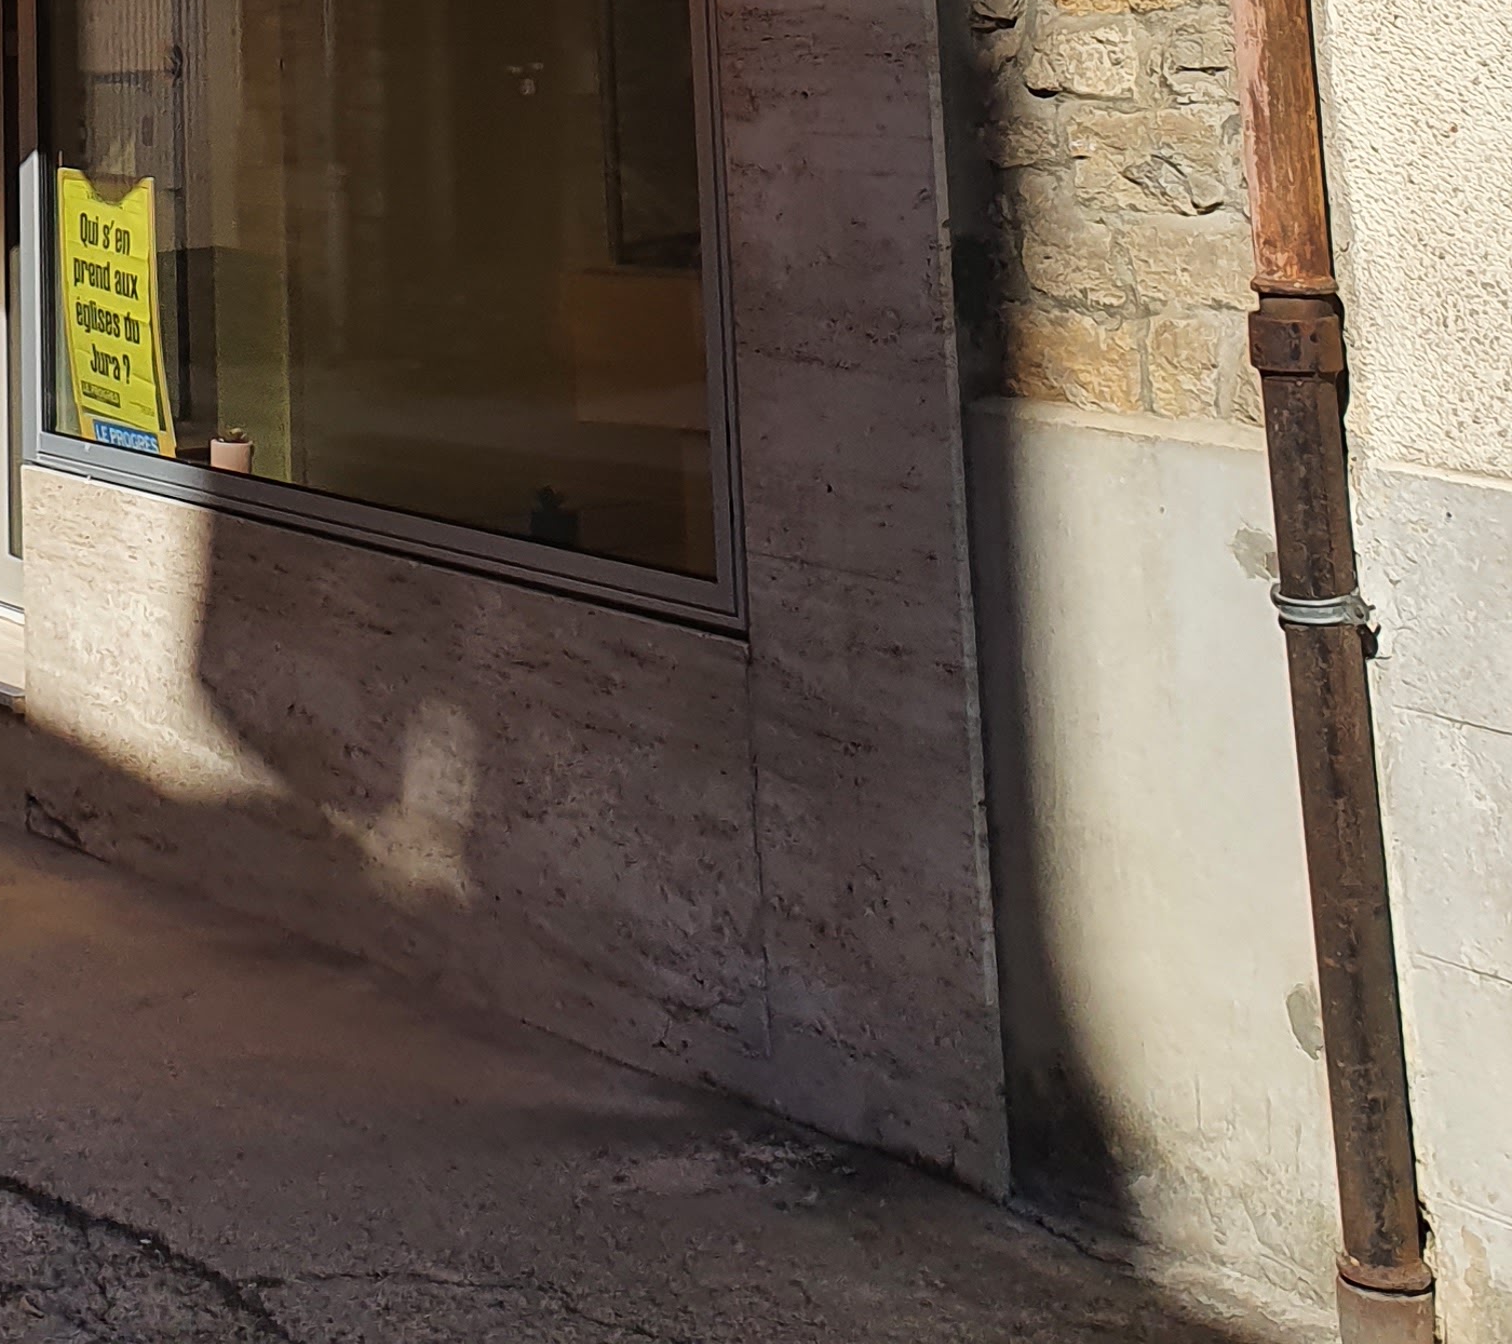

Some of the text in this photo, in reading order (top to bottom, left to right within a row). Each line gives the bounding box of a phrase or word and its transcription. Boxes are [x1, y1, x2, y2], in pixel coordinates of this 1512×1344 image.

[80, 212, 130, 256] Qui s'en
[73, 257, 139, 301] prend aux
[75, 296, 140, 344] églises du
[90, 343, 121, 381] Jura
[95, 423, 109, 443] LE
